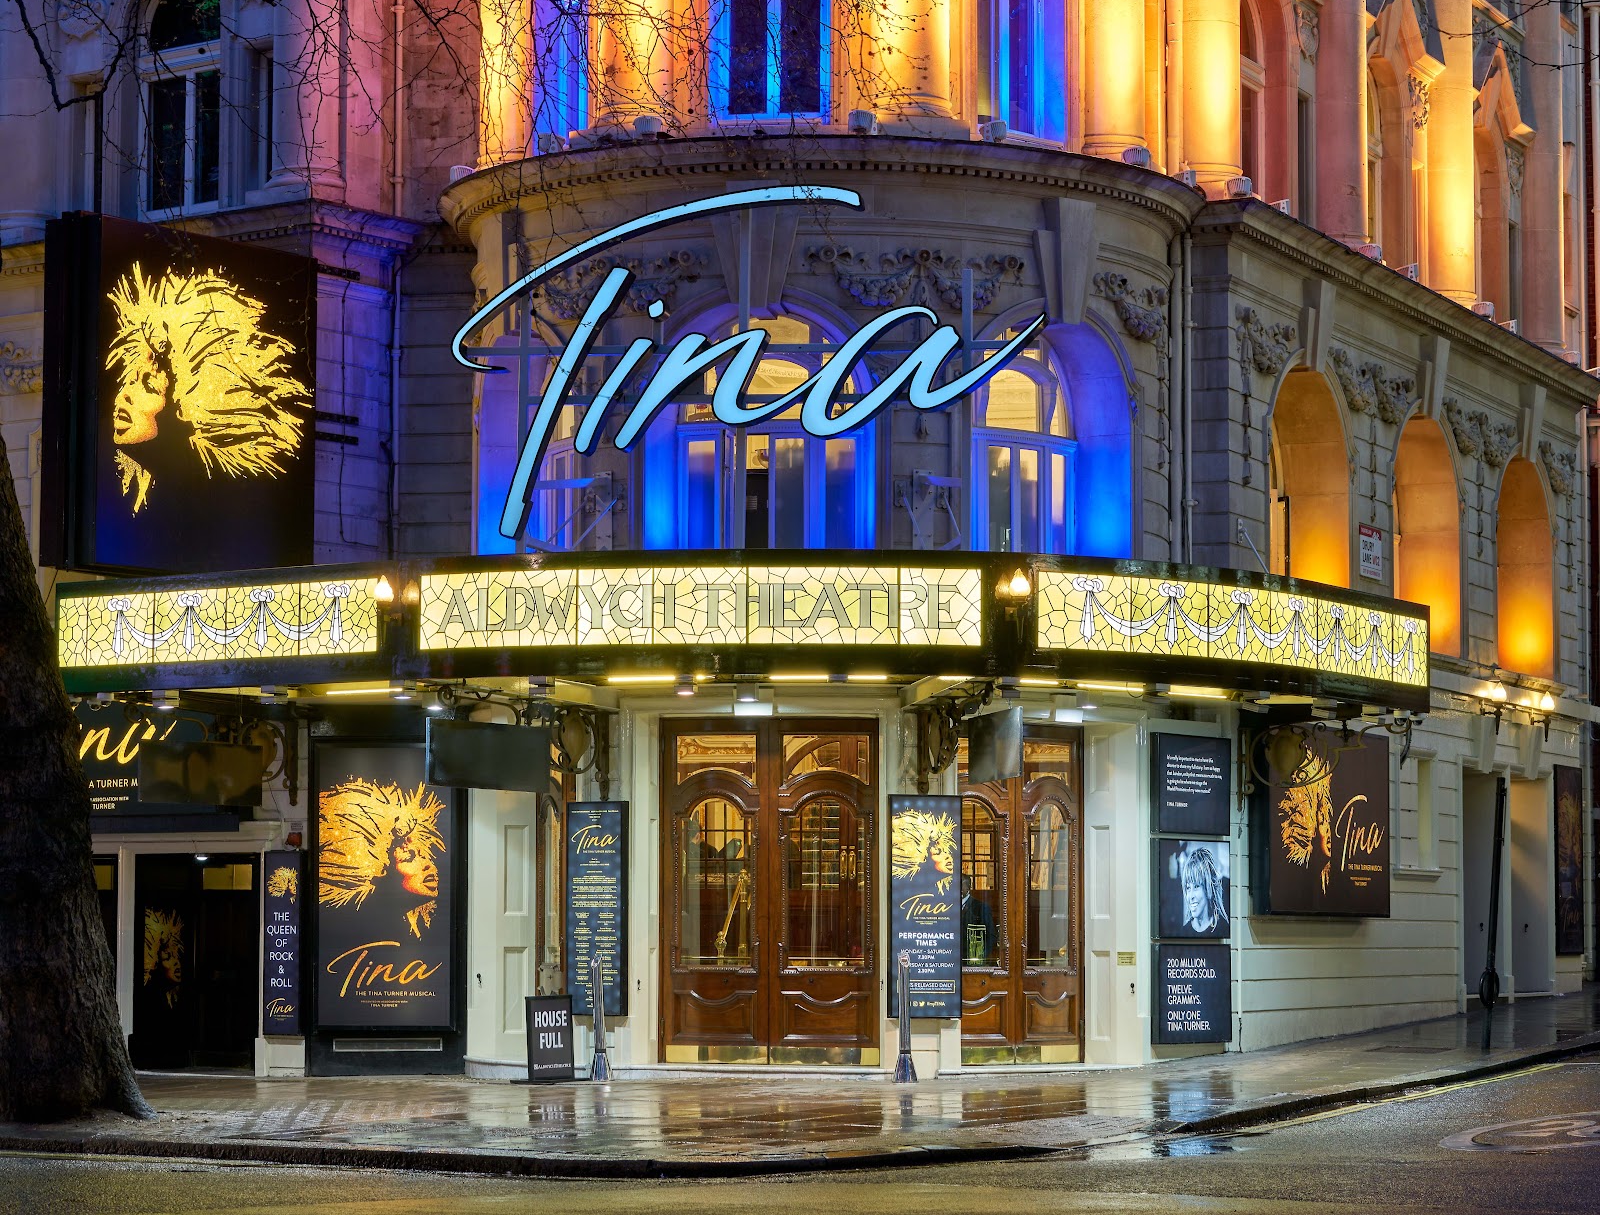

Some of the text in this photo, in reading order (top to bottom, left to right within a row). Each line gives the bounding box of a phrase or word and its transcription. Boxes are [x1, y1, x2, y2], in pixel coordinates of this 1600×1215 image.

[451, 184, 1050, 541] Tina
[1362, 539, 1375, 552] DRURY
[1362, 552, 1372, 564] LANE
[437, 583, 962, 633] ALDWYCH THEATRE
[97, 778, 129, 788] TURNER
[1335, 794, 1385, 872] Tina
[570, 824, 619, 855] Tina
[899, 893, 954, 921] Tina
[273, 911, 290, 921] THE
[266, 925, 297, 935] QUEEN
[898, 932, 955, 940] PERFORMANCE
[275, 938, 288, 948] OF
[269, 951, 294, 961] ROCK
[1167, 958, 1206, 968] 200 MILLION
[278, 964, 285, 974] &
[326, 940, 443, 998] Tina
[1167, 969, 1217, 978] RECORDS SOLD.
[270, 977, 293, 987] ROLL
[1167, 984, 1193, 994] TWELVE
[1167, 995, 1202, 1005] GRAMMYS.
[266, 997, 296, 1017] Tina
[534, 1009, 568, 1028] HOUSE
[1167, 1010, 1201, 1020] ONLY ONE
[1167, 1021, 1211, 1031] TINA TURNER.
[539, 1031, 564, 1049] FULL
